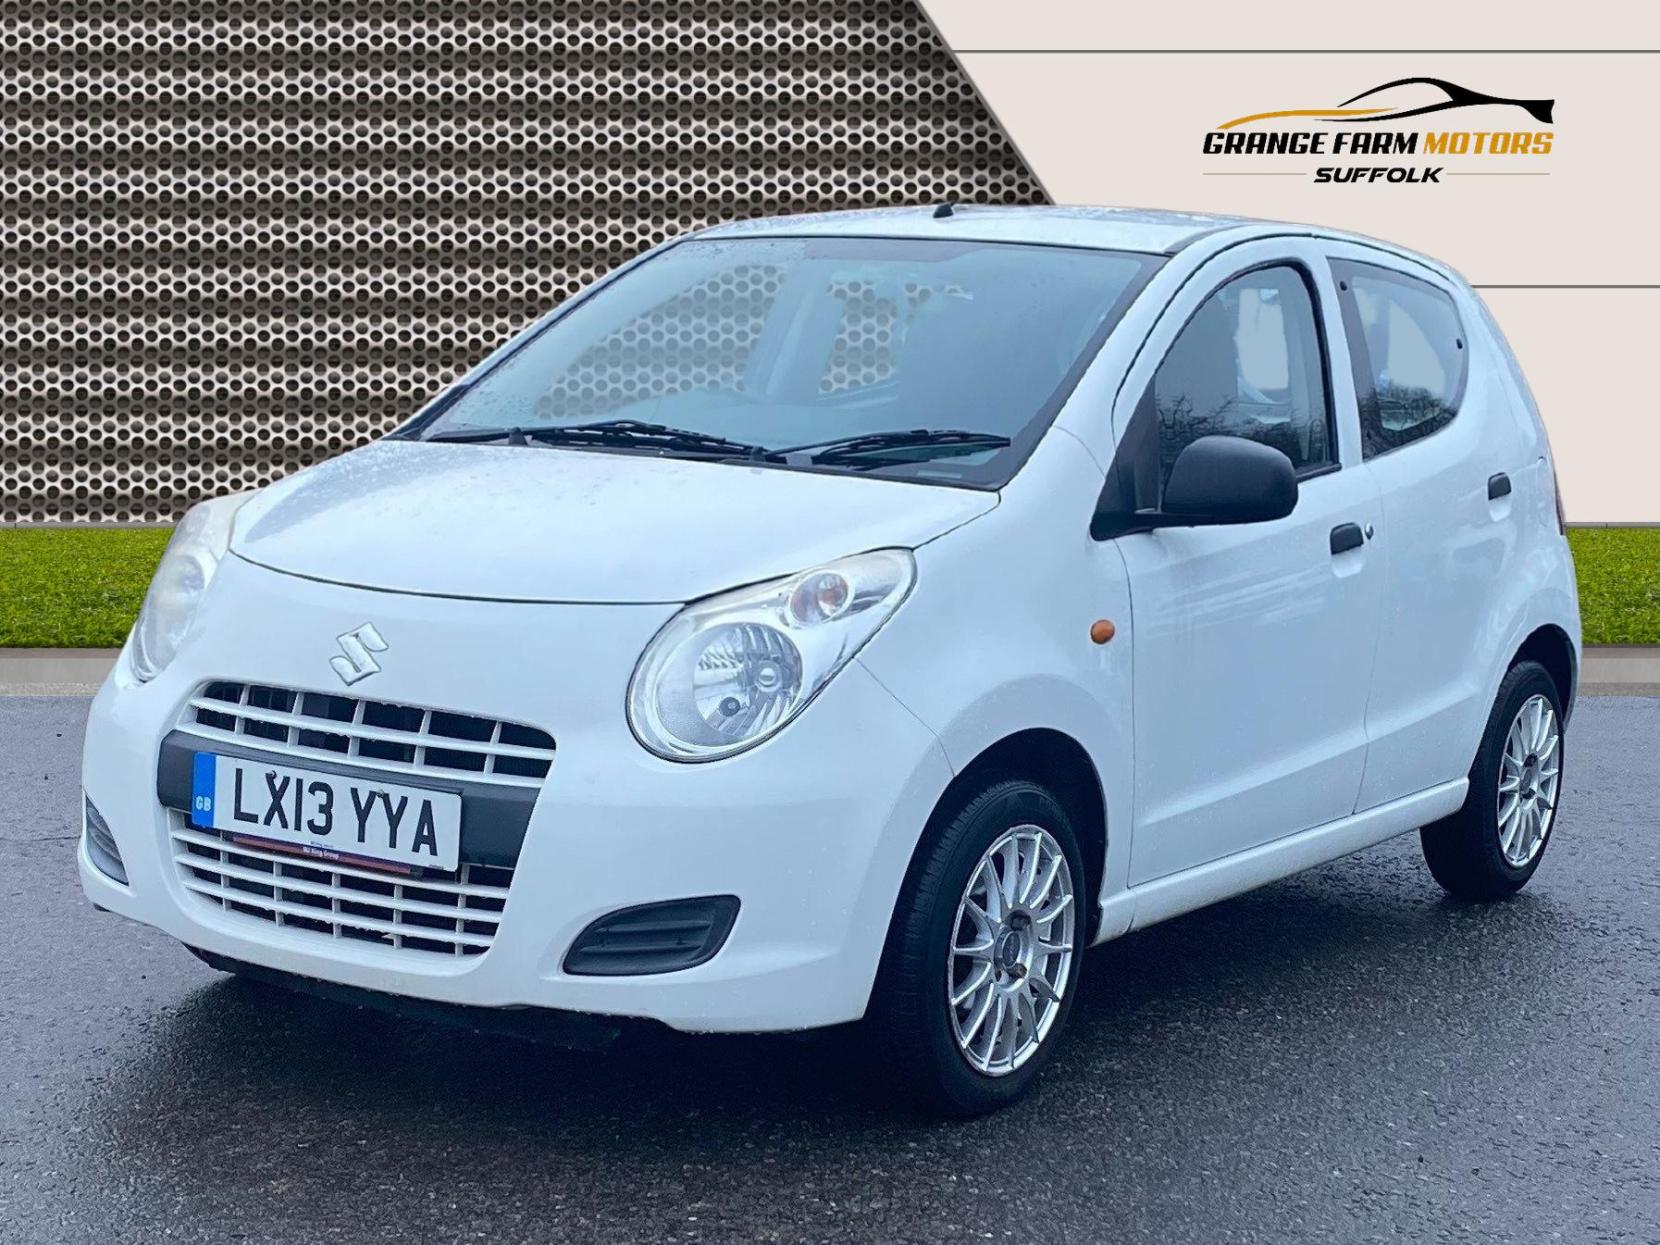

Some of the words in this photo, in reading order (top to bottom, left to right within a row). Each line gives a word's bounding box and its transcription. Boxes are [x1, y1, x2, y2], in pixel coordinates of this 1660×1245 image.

[195, 795, 212, 812] GB
[233, 767, 334, 836] LX13
[350, 787, 438, 857] YYA
